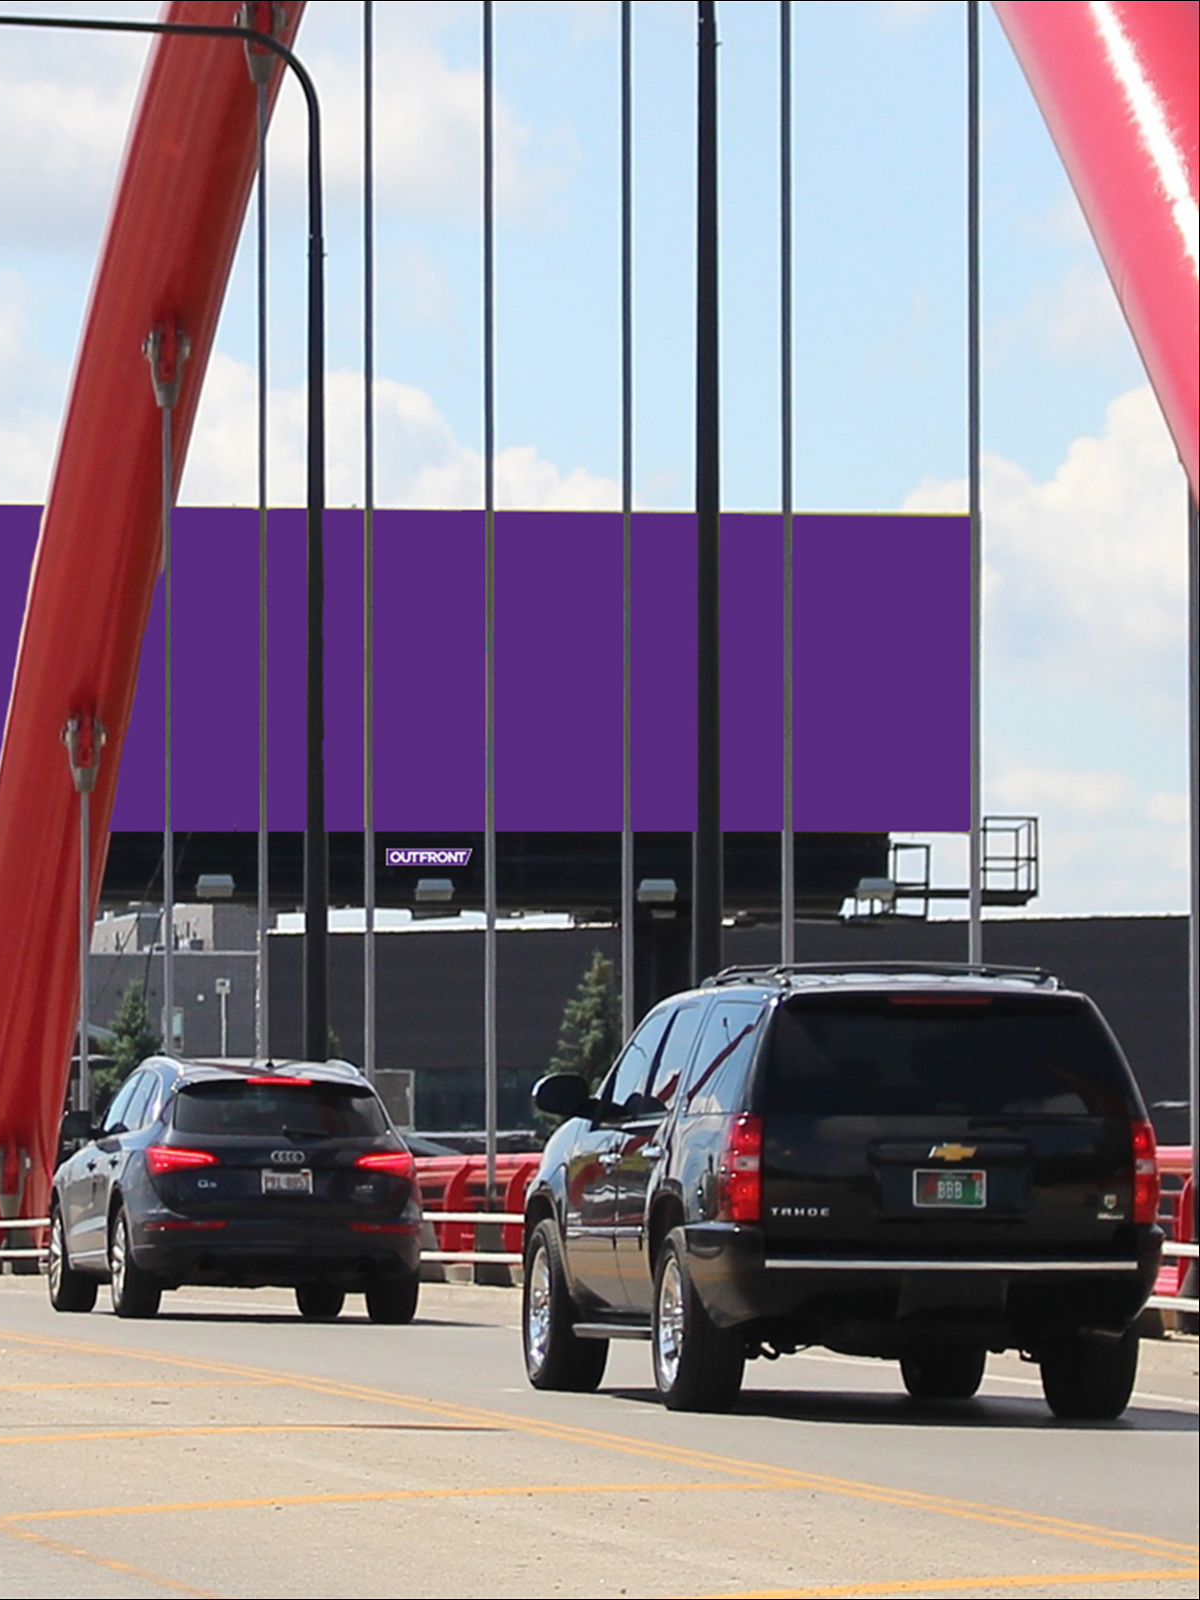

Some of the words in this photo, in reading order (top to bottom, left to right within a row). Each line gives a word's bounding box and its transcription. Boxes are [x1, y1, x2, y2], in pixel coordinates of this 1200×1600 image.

[390, 851, 467, 863] OUTFRONT
[937, 1181, 963, 1200] BBB
[771, 1207, 830, 1217] TAHOE
